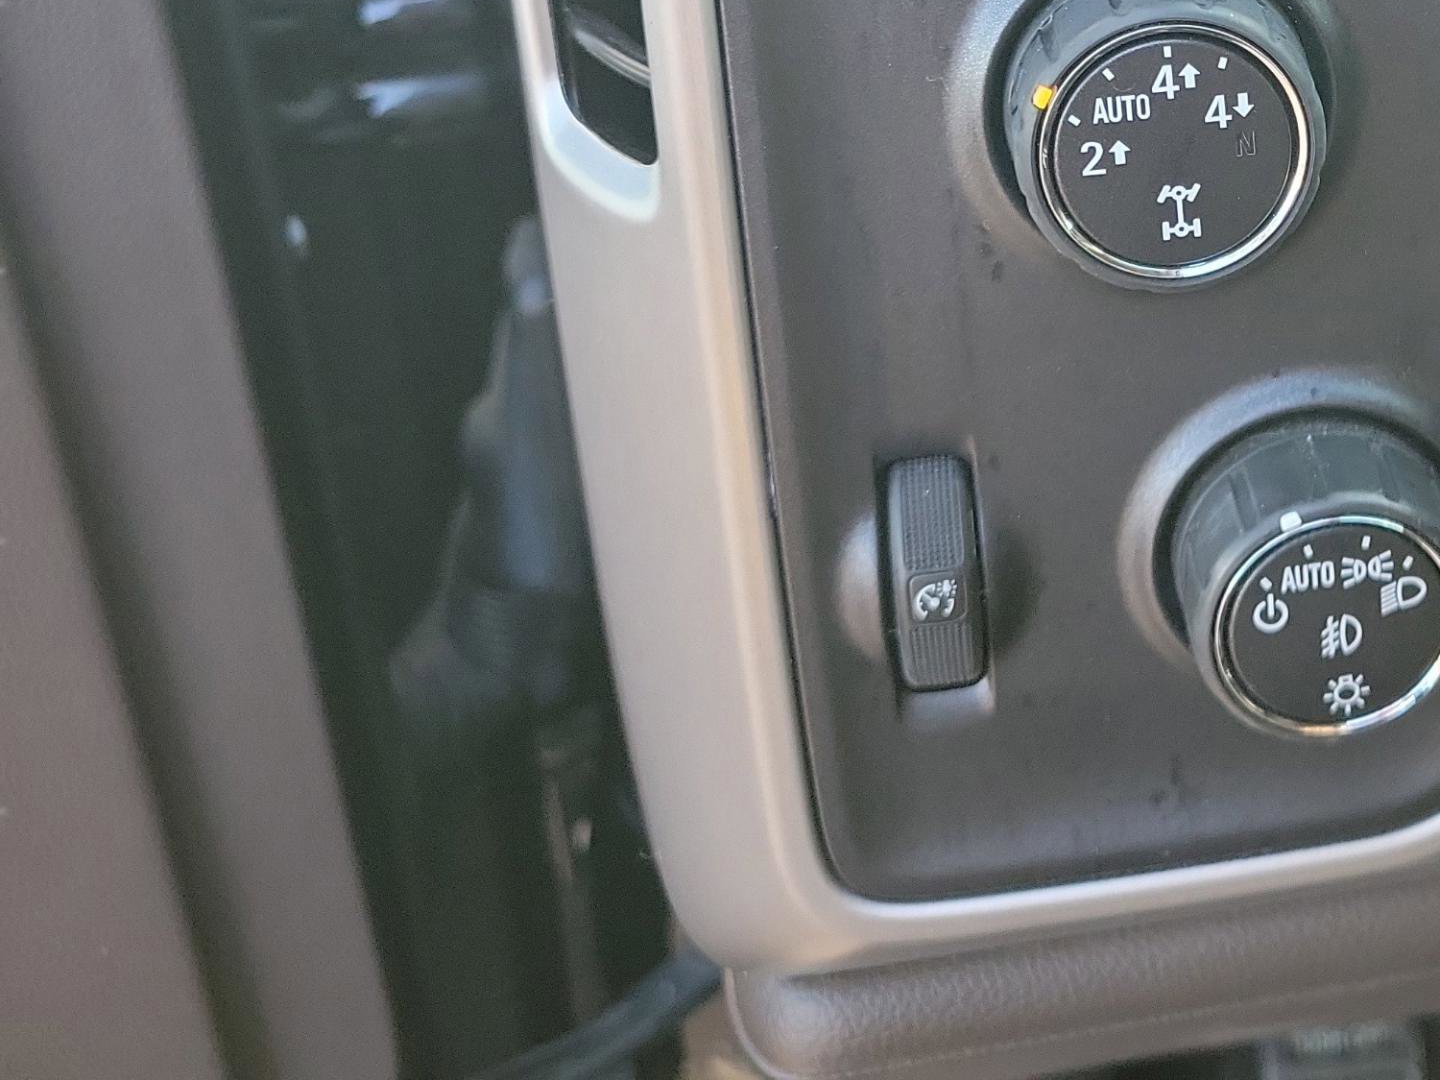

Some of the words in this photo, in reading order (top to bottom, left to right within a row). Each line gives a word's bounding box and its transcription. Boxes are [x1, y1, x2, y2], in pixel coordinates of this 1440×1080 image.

[1151, 64, 1181, 101] 4
[1093, 93, 1151, 126] AUTO
[1204, 94, 1233, 130] 4
[1079, 141, 1107, 177] 2
[1236, 130, 1256, 158] N
[1281, 560, 1335, 595] AUTO
